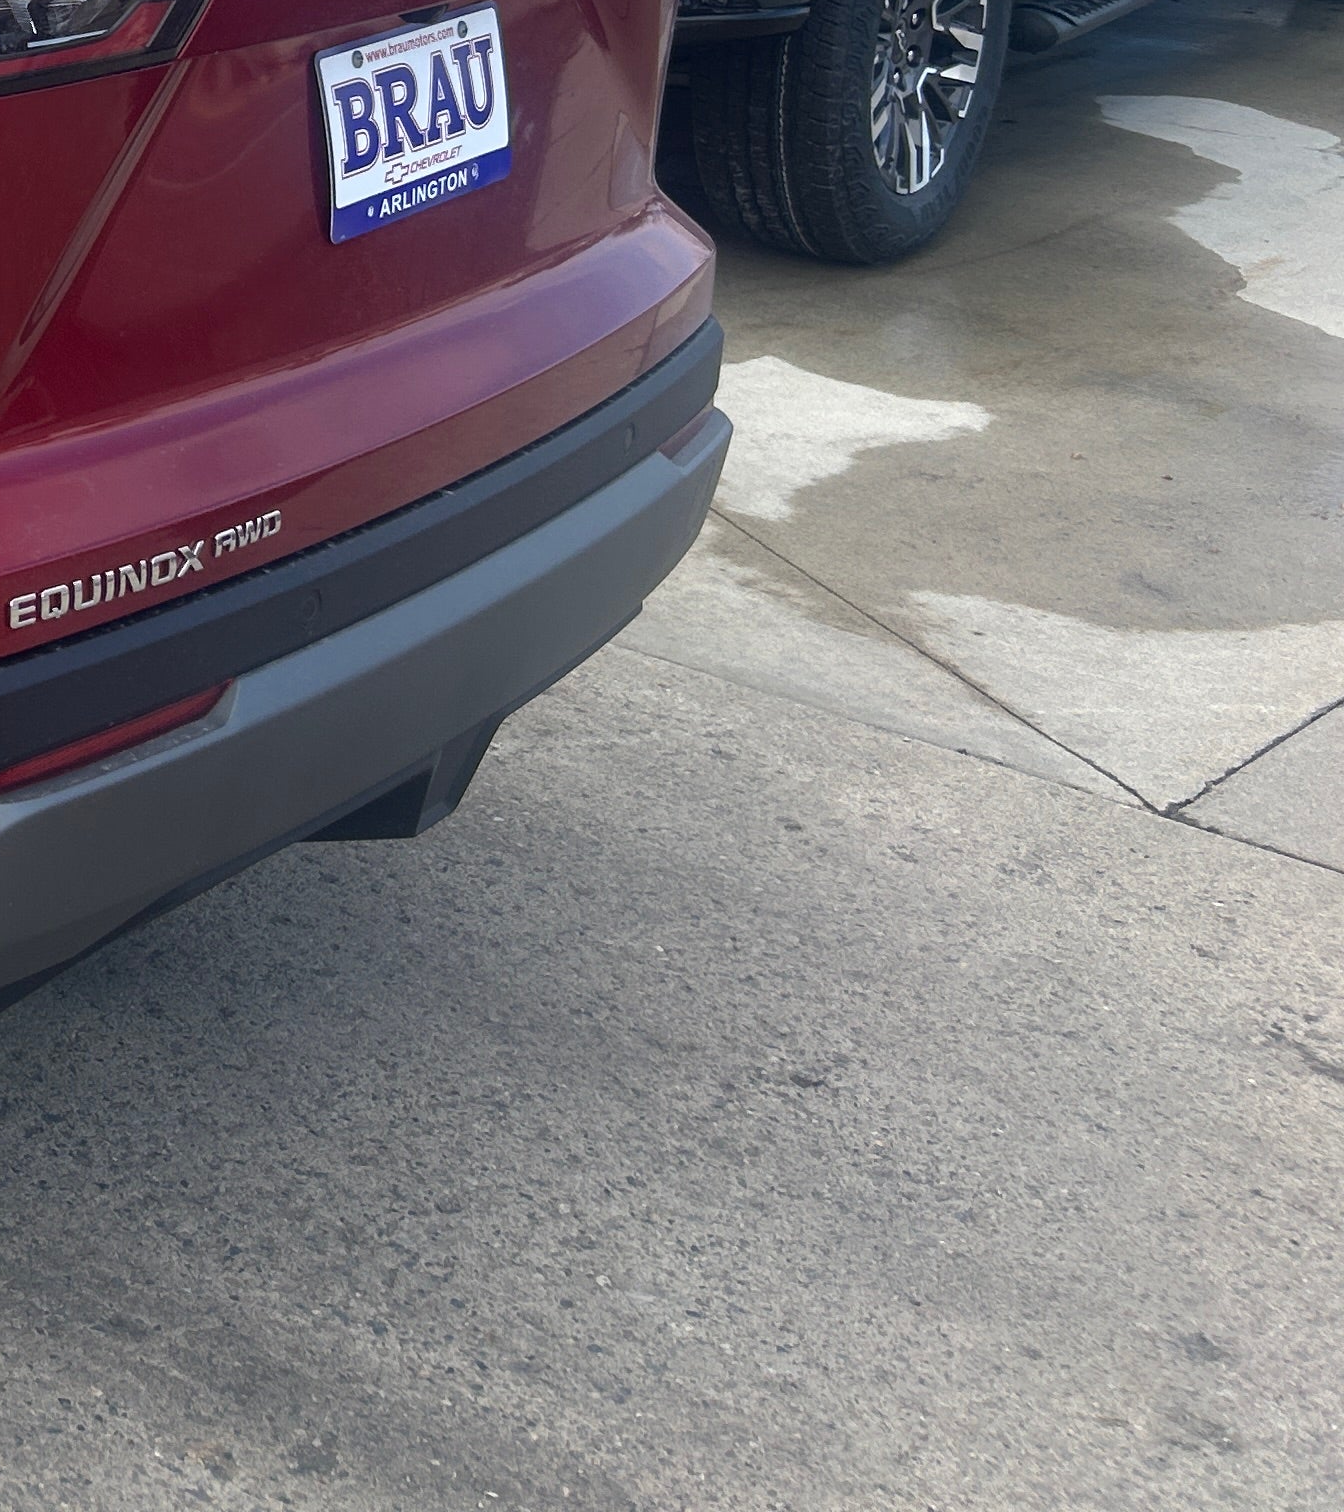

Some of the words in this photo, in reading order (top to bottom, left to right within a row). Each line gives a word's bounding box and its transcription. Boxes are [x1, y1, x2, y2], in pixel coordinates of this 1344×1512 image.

[365, 25, 455, 63] www.braumotors.com
[330, 32, 495, 180] BRAU
[409, 144, 463, 174] CHEVROLET
[378, 167, 468, 219] ARLINGTON
[8, 539, 206, 630] EQUINOX
[213, 508, 282, 559] AWD
